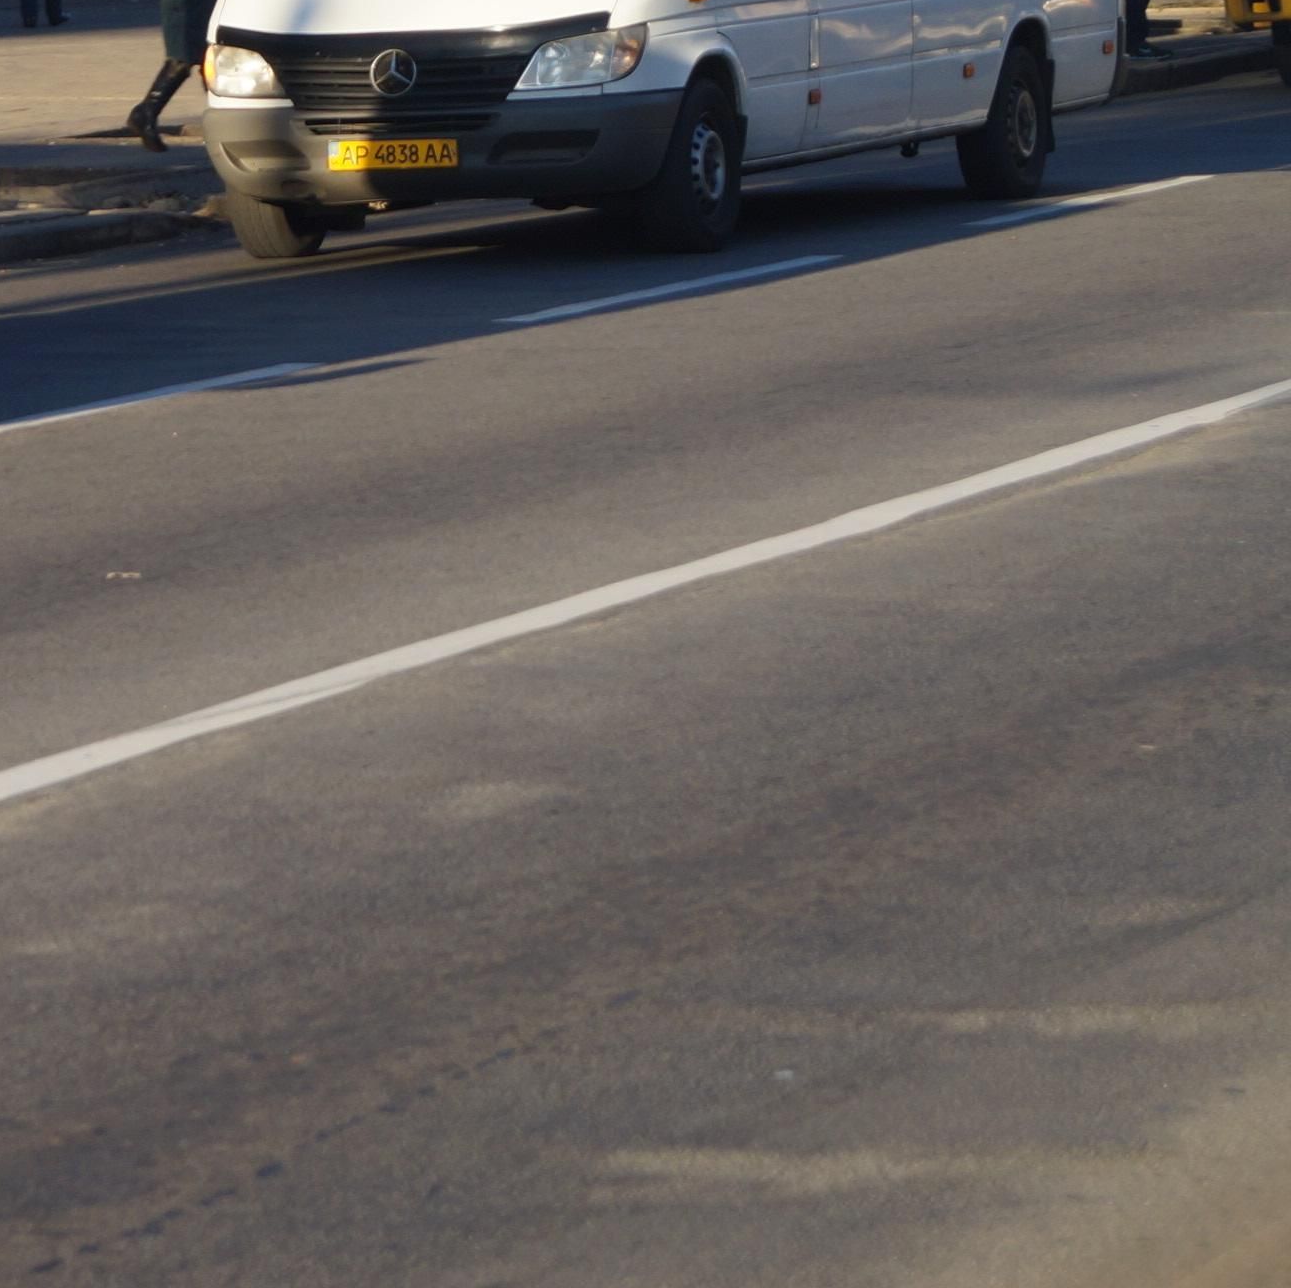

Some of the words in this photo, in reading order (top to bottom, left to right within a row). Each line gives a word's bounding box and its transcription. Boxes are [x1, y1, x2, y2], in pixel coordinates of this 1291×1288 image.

[342, 145, 369, 166] AP
[374, 144, 420, 164] 4838
[425, 143, 453, 163] AA
